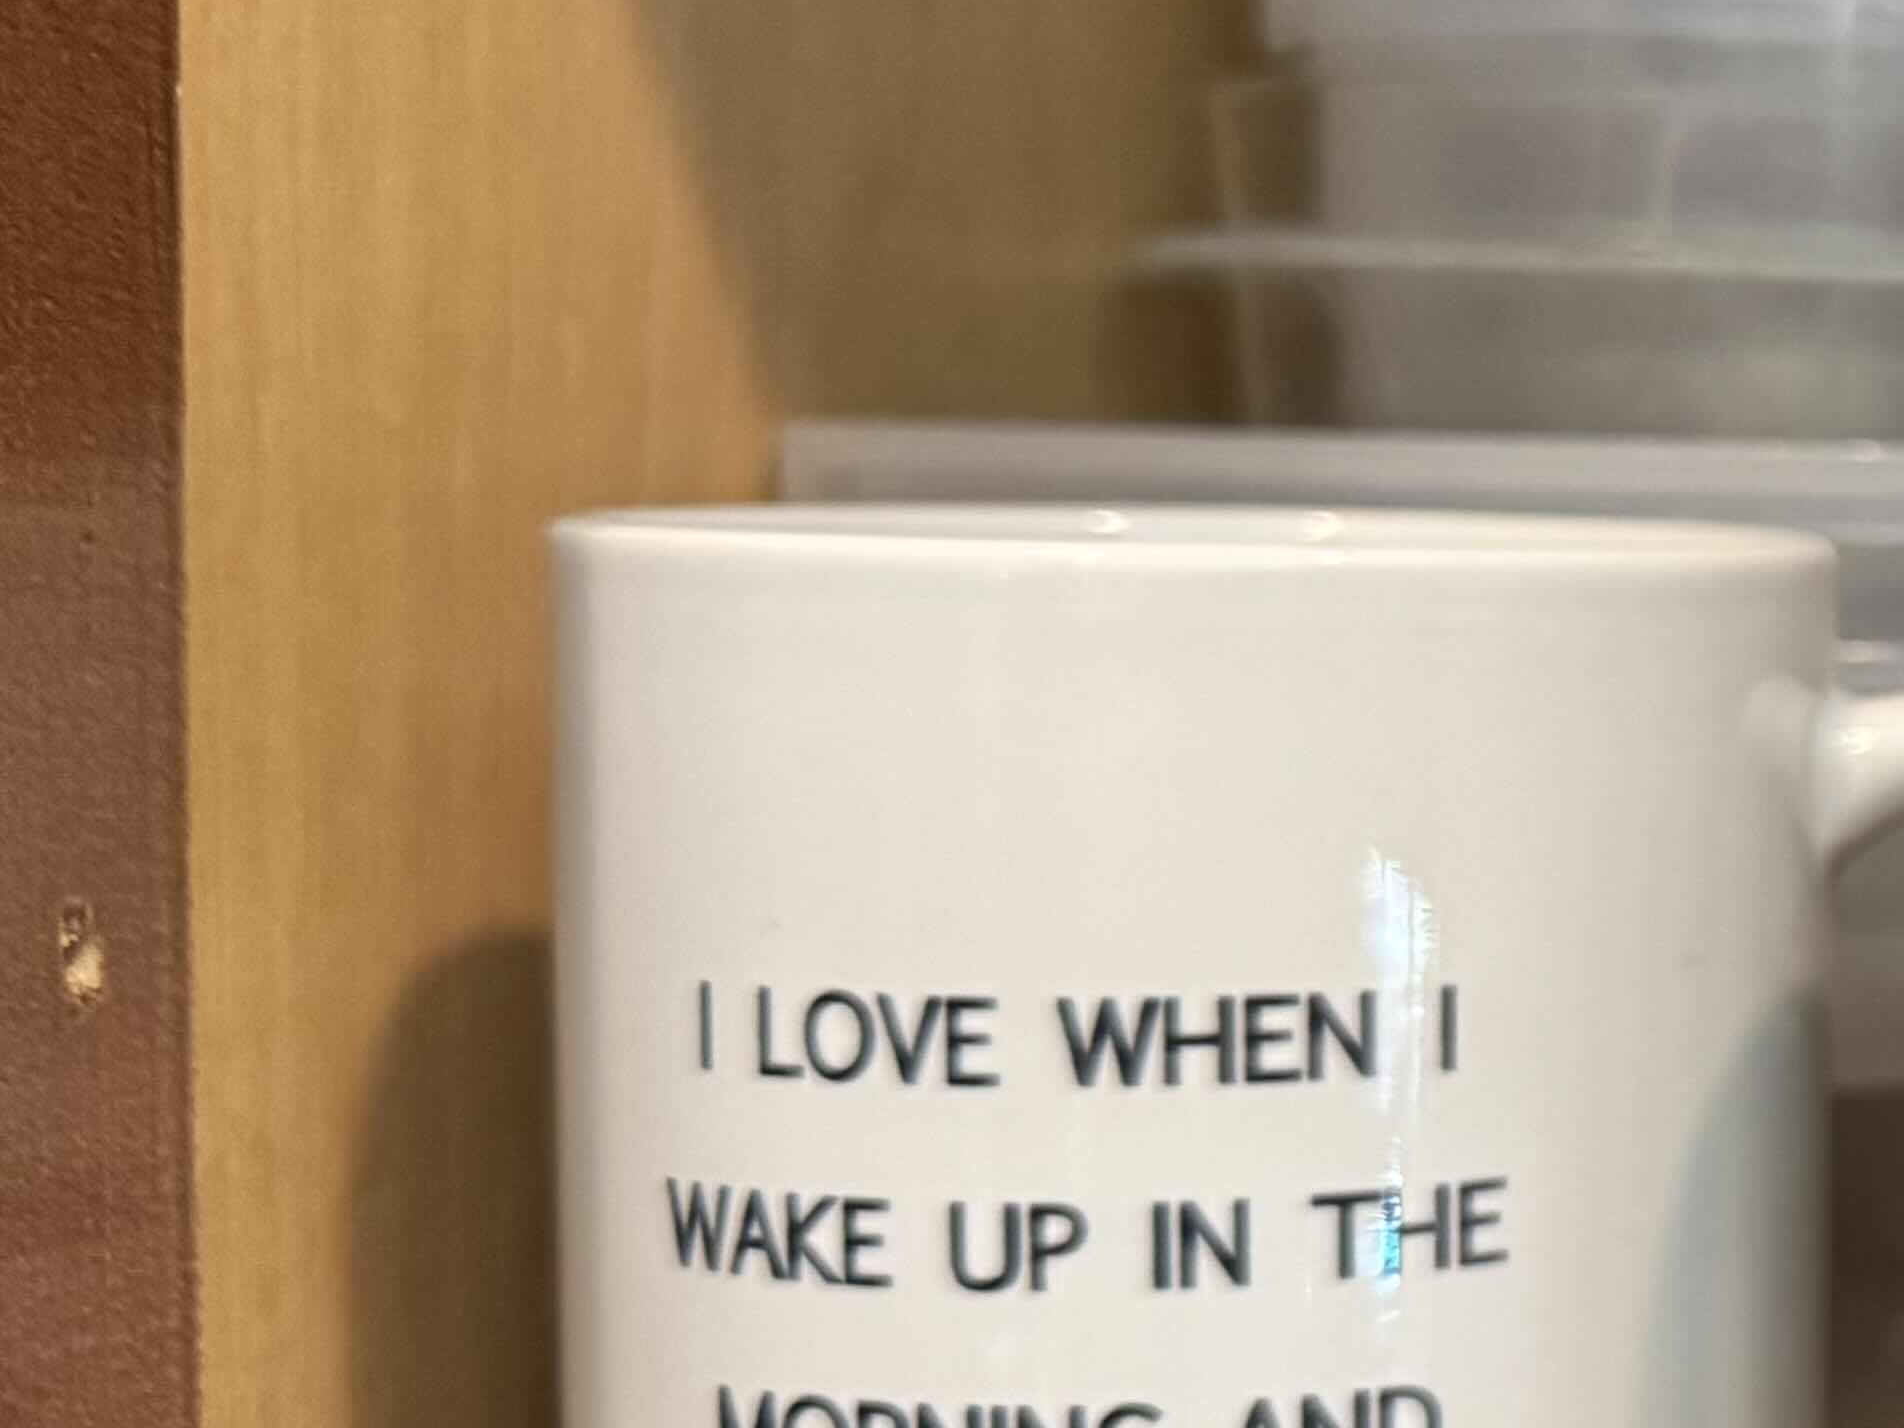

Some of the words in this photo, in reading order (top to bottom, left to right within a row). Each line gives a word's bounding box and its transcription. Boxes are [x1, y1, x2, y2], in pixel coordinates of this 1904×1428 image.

[699, 980, 713, 1070] I
[755, 985, 1000, 1087] LOVE
[1055, 989, 1378, 1087] WHEN
[1440, 984, 1459, 1070] I
[666, 1176, 893, 1288] WAKE
[948, 1200, 1089, 1291] UP
[1151, 1198, 1251, 1291] IN
[1310, 1174, 1509, 1279] THE
